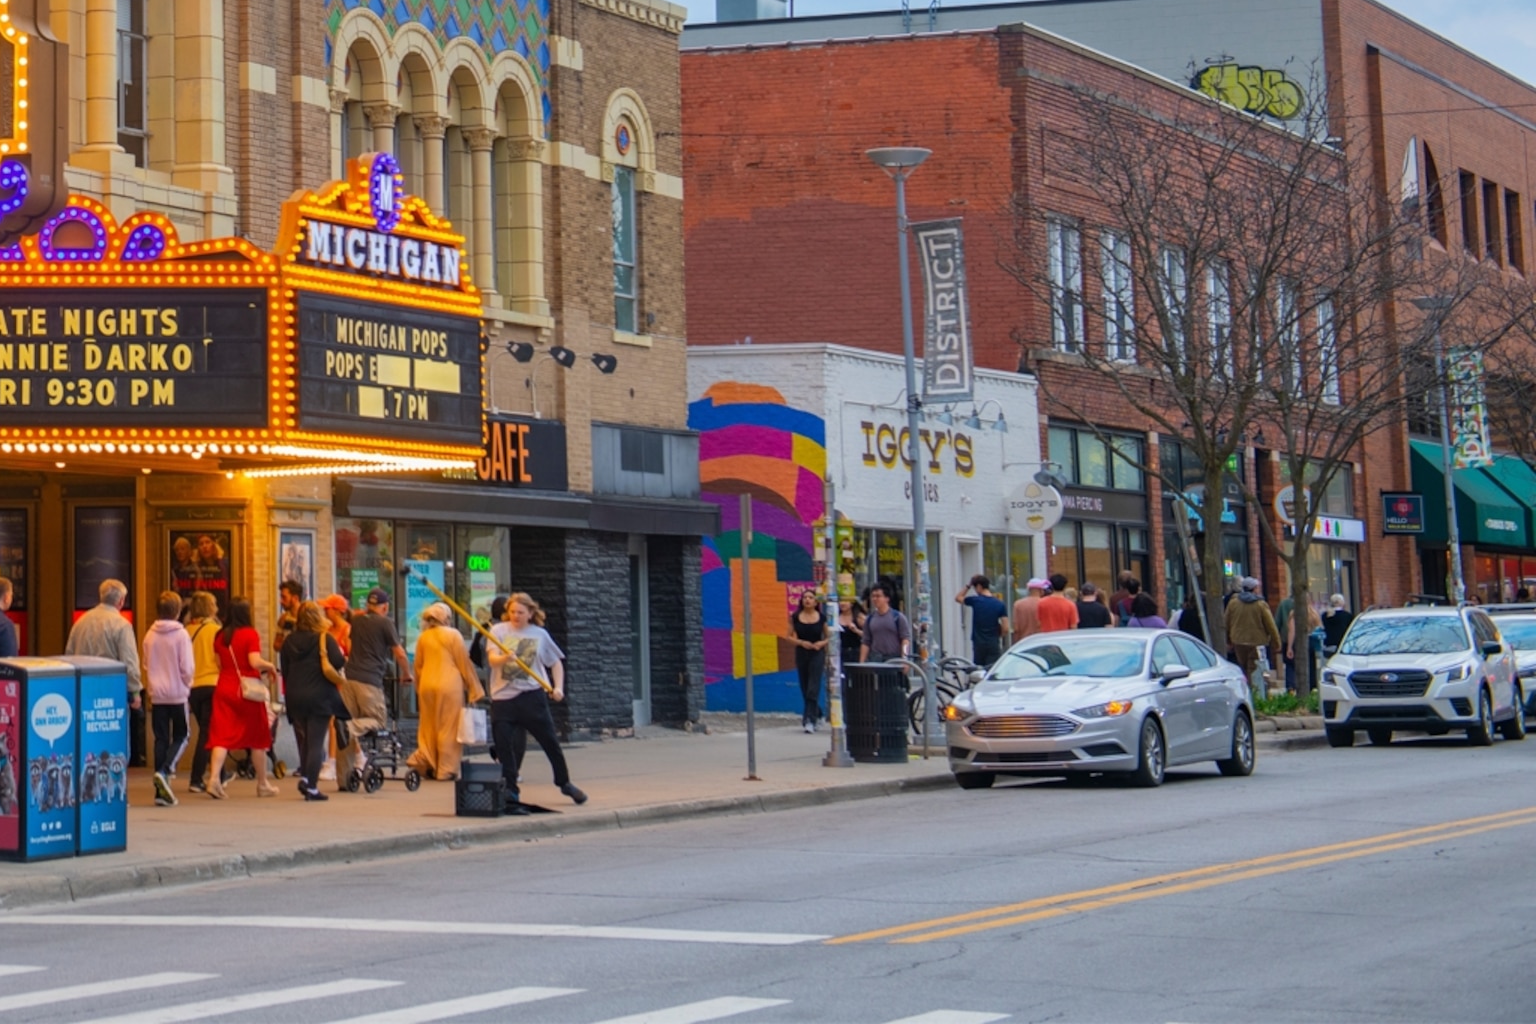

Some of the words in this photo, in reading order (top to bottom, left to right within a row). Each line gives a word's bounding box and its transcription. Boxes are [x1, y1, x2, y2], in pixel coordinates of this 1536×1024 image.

[307, 220, 460, 286] MICHIGAN
[63, 308, 179, 337] NIGHTS
[929, 238, 961, 385] DISTRICT
[336, 317, 407, 352] MICHIGAN
[412, 328, 448, 357] POPS
[83, 343, 193, 371] DARKO
[326, 350, 364, 382] POPS
[46, 378, 116, 406] 9:30
[130, 378, 175, 406] PM
[408, 393, 429, 421] PM
[478, 422, 532, 483] CAFE
[861, 420, 975, 478] IGGY'S
[468, 554, 491, 570] OPEN
[83, 711, 96, 721] THE
